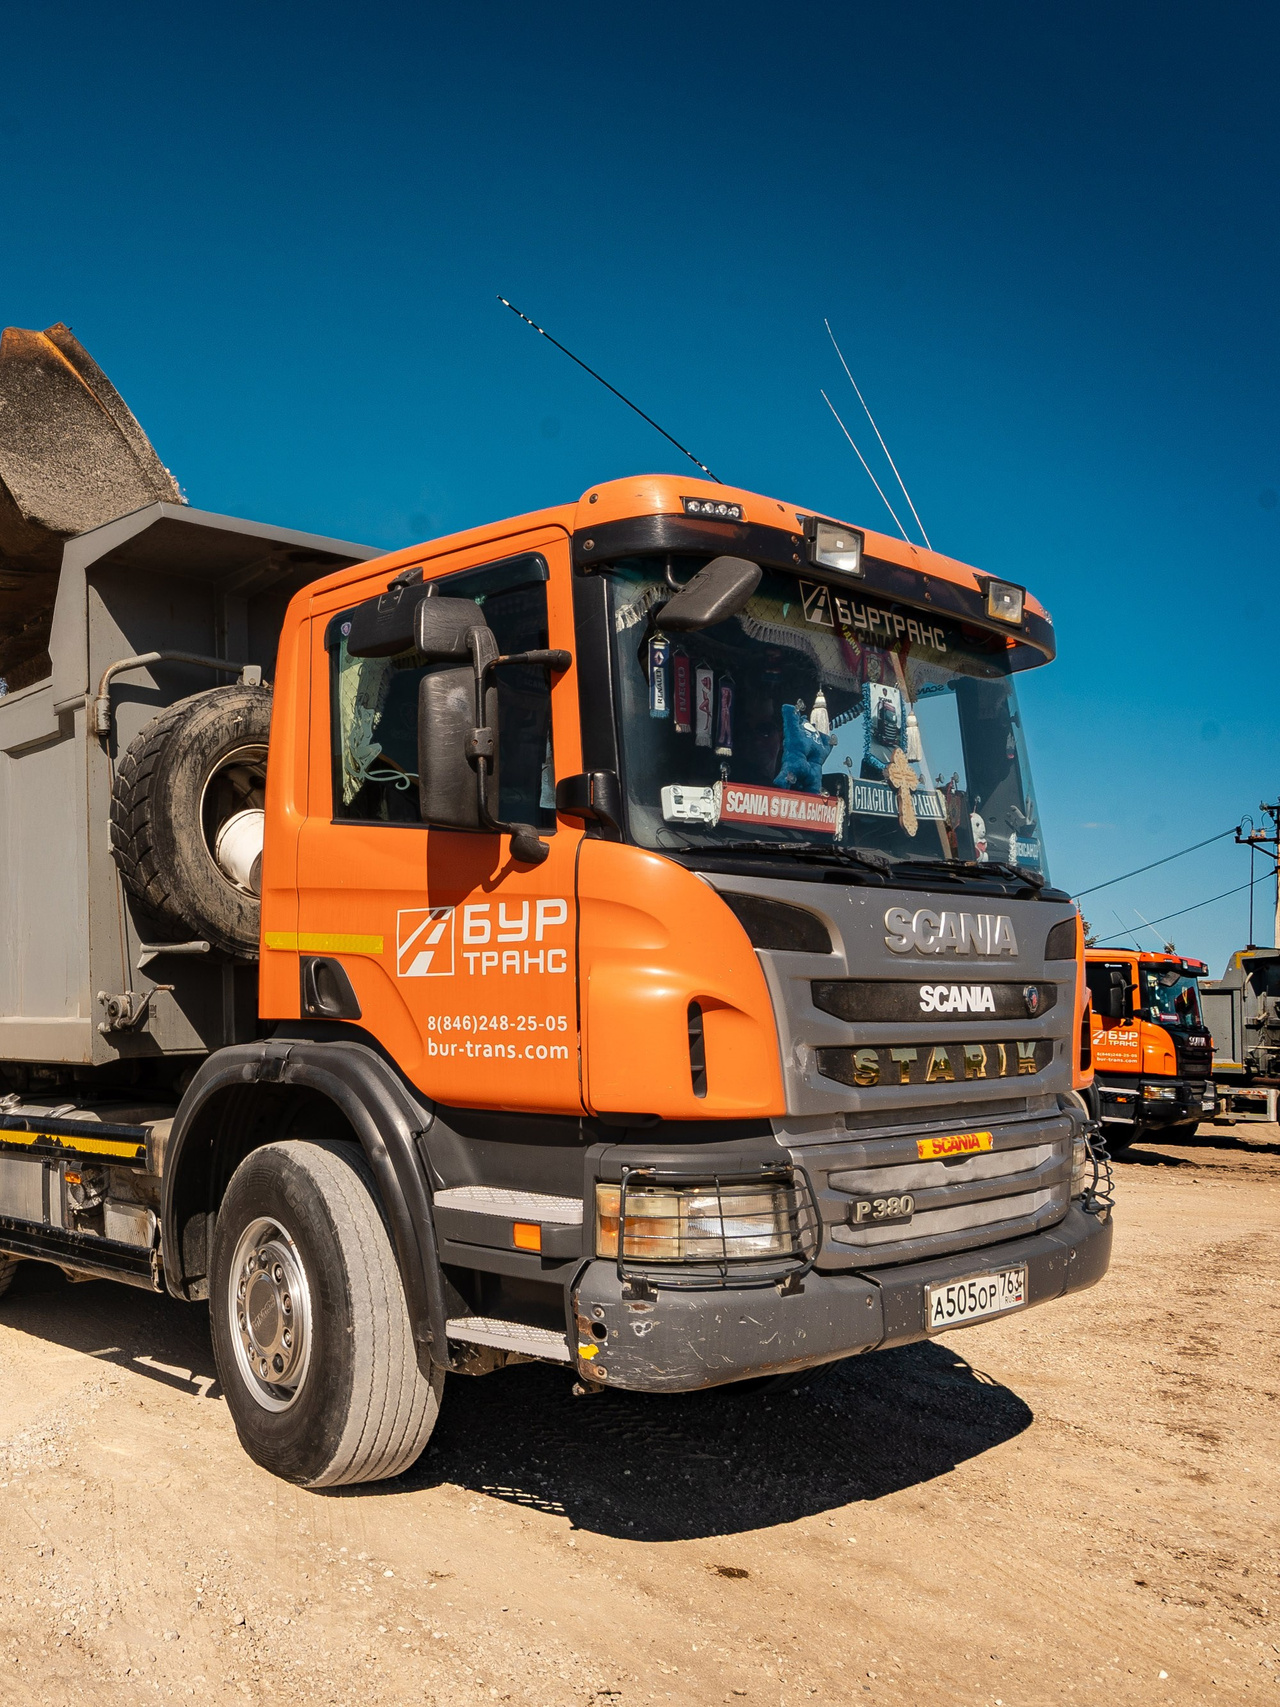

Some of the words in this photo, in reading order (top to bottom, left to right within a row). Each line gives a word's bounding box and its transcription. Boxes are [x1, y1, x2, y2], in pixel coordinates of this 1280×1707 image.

[835, 597, 947, 652] БУРТРАНС
[656, 669, 664, 704] RENAULT
[677, 666, 688, 712] IVECO
[726, 790, 769, 816] SCANIA
[770, 796, 807, 821] SUKA
[807, 802, 837, 824] БЫСТРАЯ
[854, 785, 886, 812] СПАСИ
[886, 790, 895, 813] И
[462, 898, 568, 945] БУР
[884, 907, 1019, 957] SCANIA
[462, 948, 567, 976] ТРАНС
[919, 985, 996, 1013] SCANIA
[427, 1015, 568, 1034] 8(846)248-25-05
[1108, 1030, 1139, 1041] БУР
[427, 1037, 569, 1060] bur-trans.com
[1108, 1040, 1138, 1048] ТРАНС
[852, 1041, 1038, 1087] STARIK
[931, 1133, 981, 1155] SCANIA
[872, 1194, 916, 1221] 380
[1004, 1295, 1016, 1304] RUS
